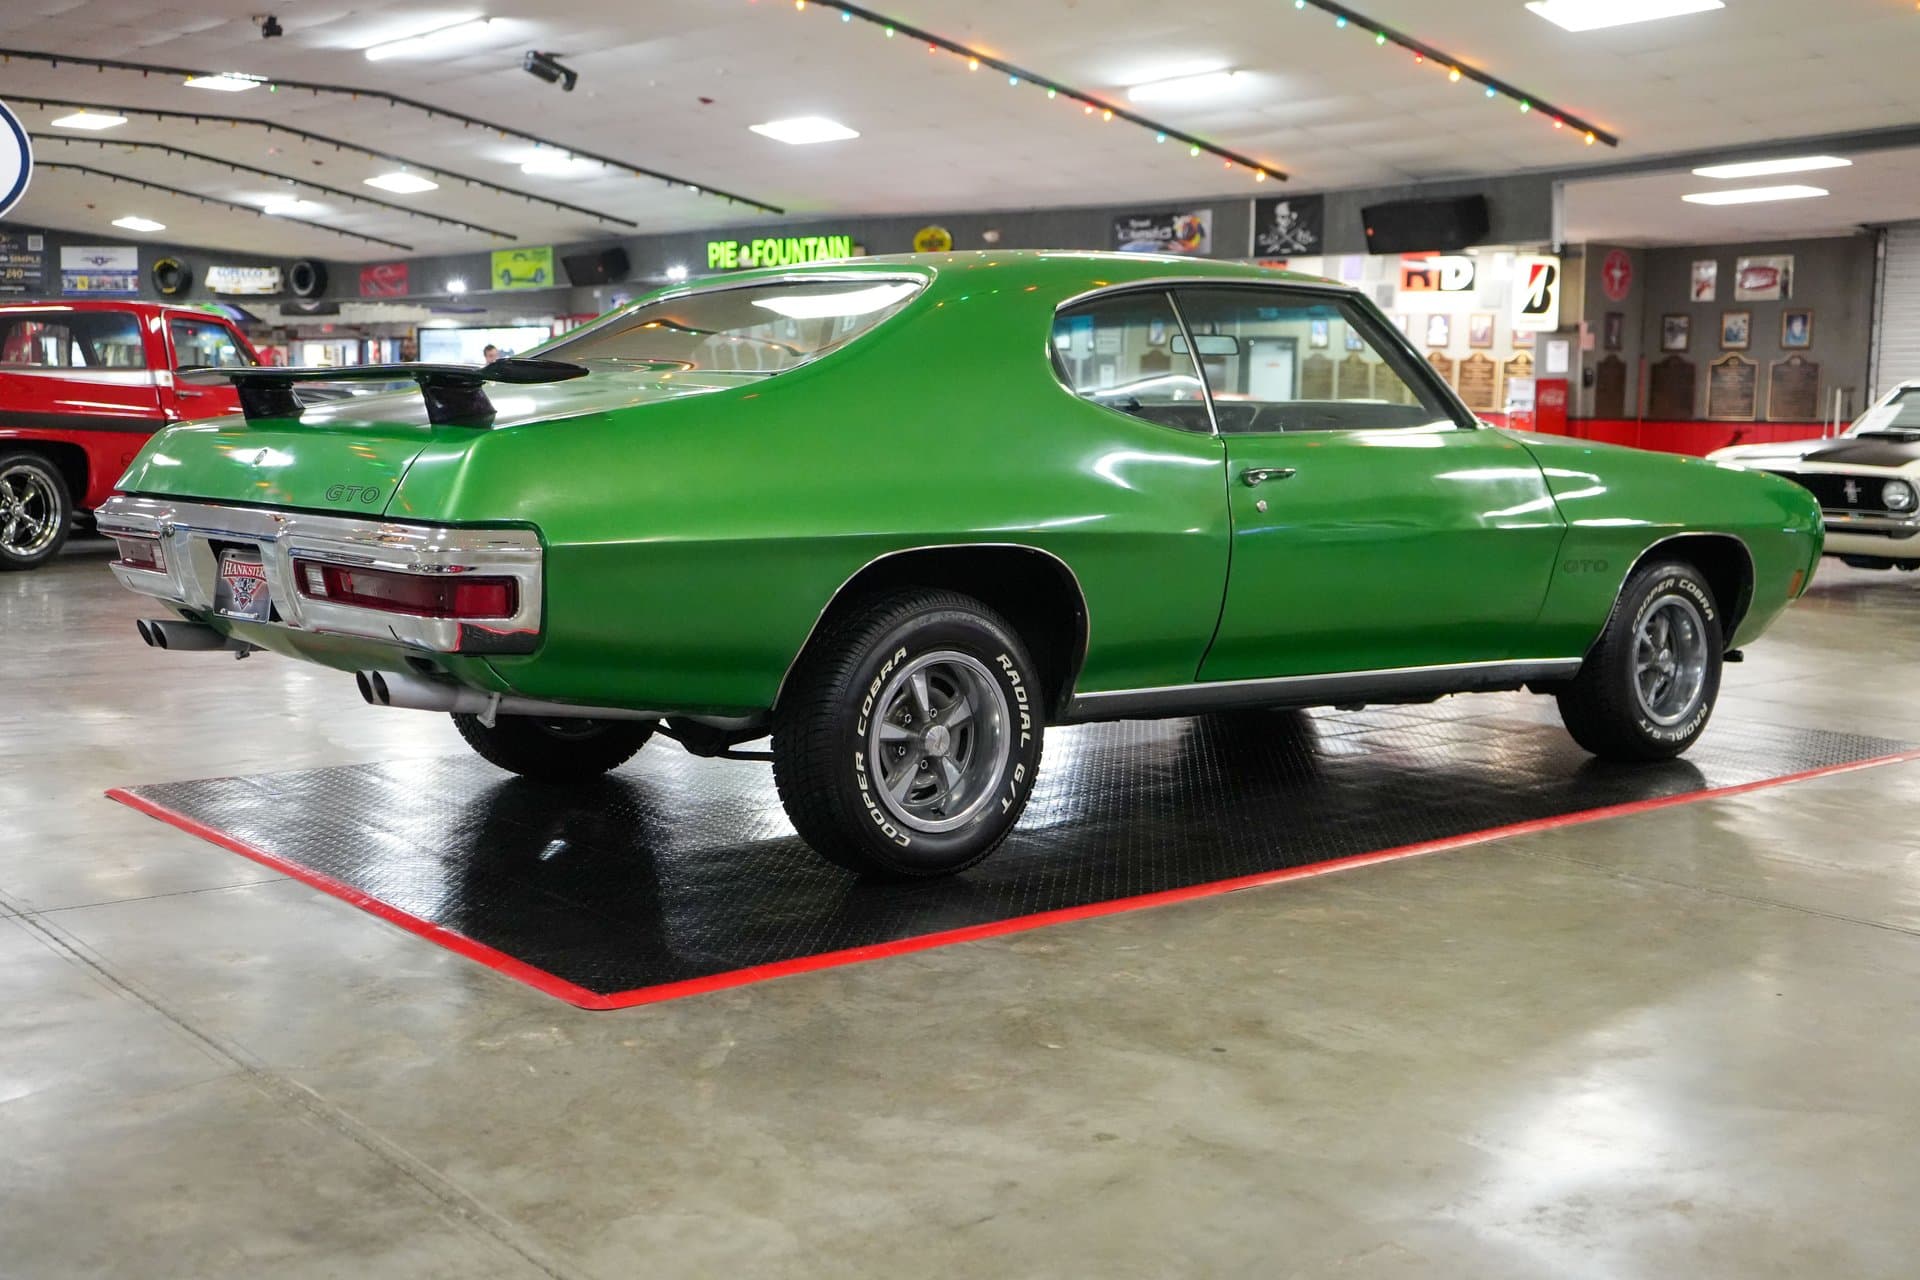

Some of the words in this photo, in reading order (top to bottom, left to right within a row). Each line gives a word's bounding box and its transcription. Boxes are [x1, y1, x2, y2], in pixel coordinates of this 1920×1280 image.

[707, 241, 737, 268] PIE
[753, 236, 850, 267] FOUNTAIN
[326, 485, 380, 504] GTO
[1563, 560, 1609, 573] GTO
[1632, 578, 1675, 634] COOPER
[1678, 578, 1715, 622] COBRA
[857, 646, 908, 737] COBRA
[996, 654, 1032, 748] RADIAL
[1671, 702, 1708, 742] RADIAL
[855, 752, 912, 848] COOPER
[1002, 762, 1026, 815] G/T
